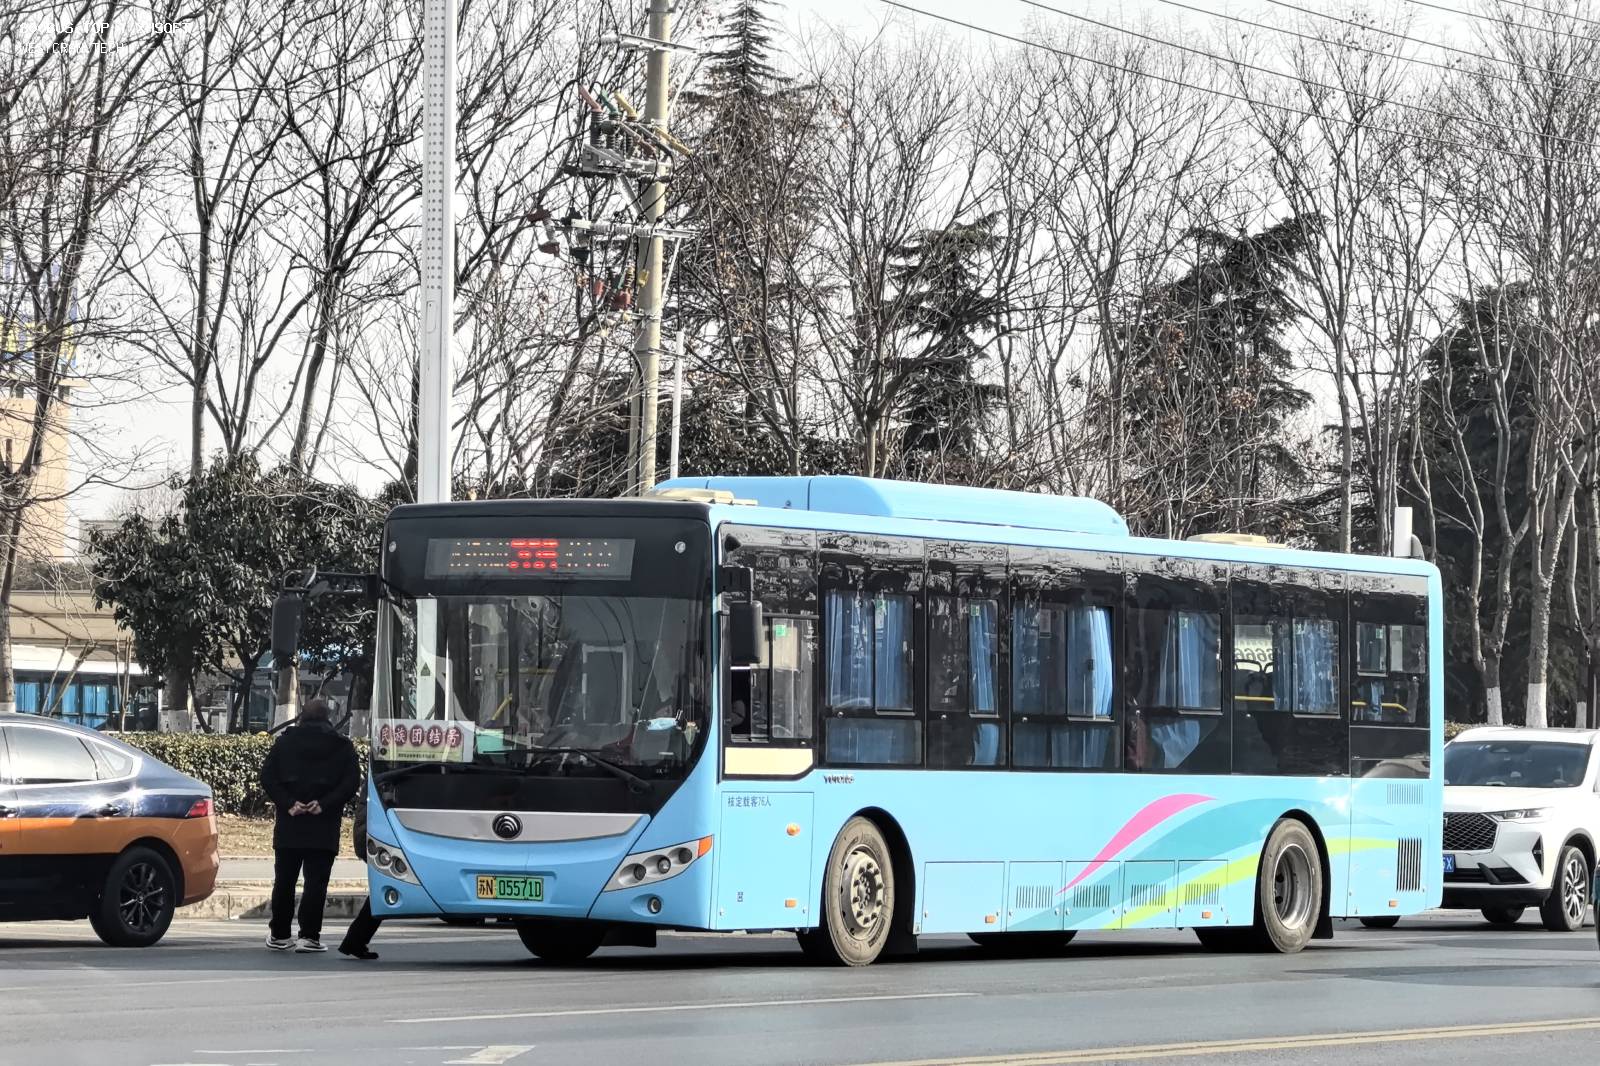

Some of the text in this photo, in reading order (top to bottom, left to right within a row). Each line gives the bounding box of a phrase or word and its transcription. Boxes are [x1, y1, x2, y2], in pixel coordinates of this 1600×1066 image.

[380, 724, 462, 747] 民族团结号
